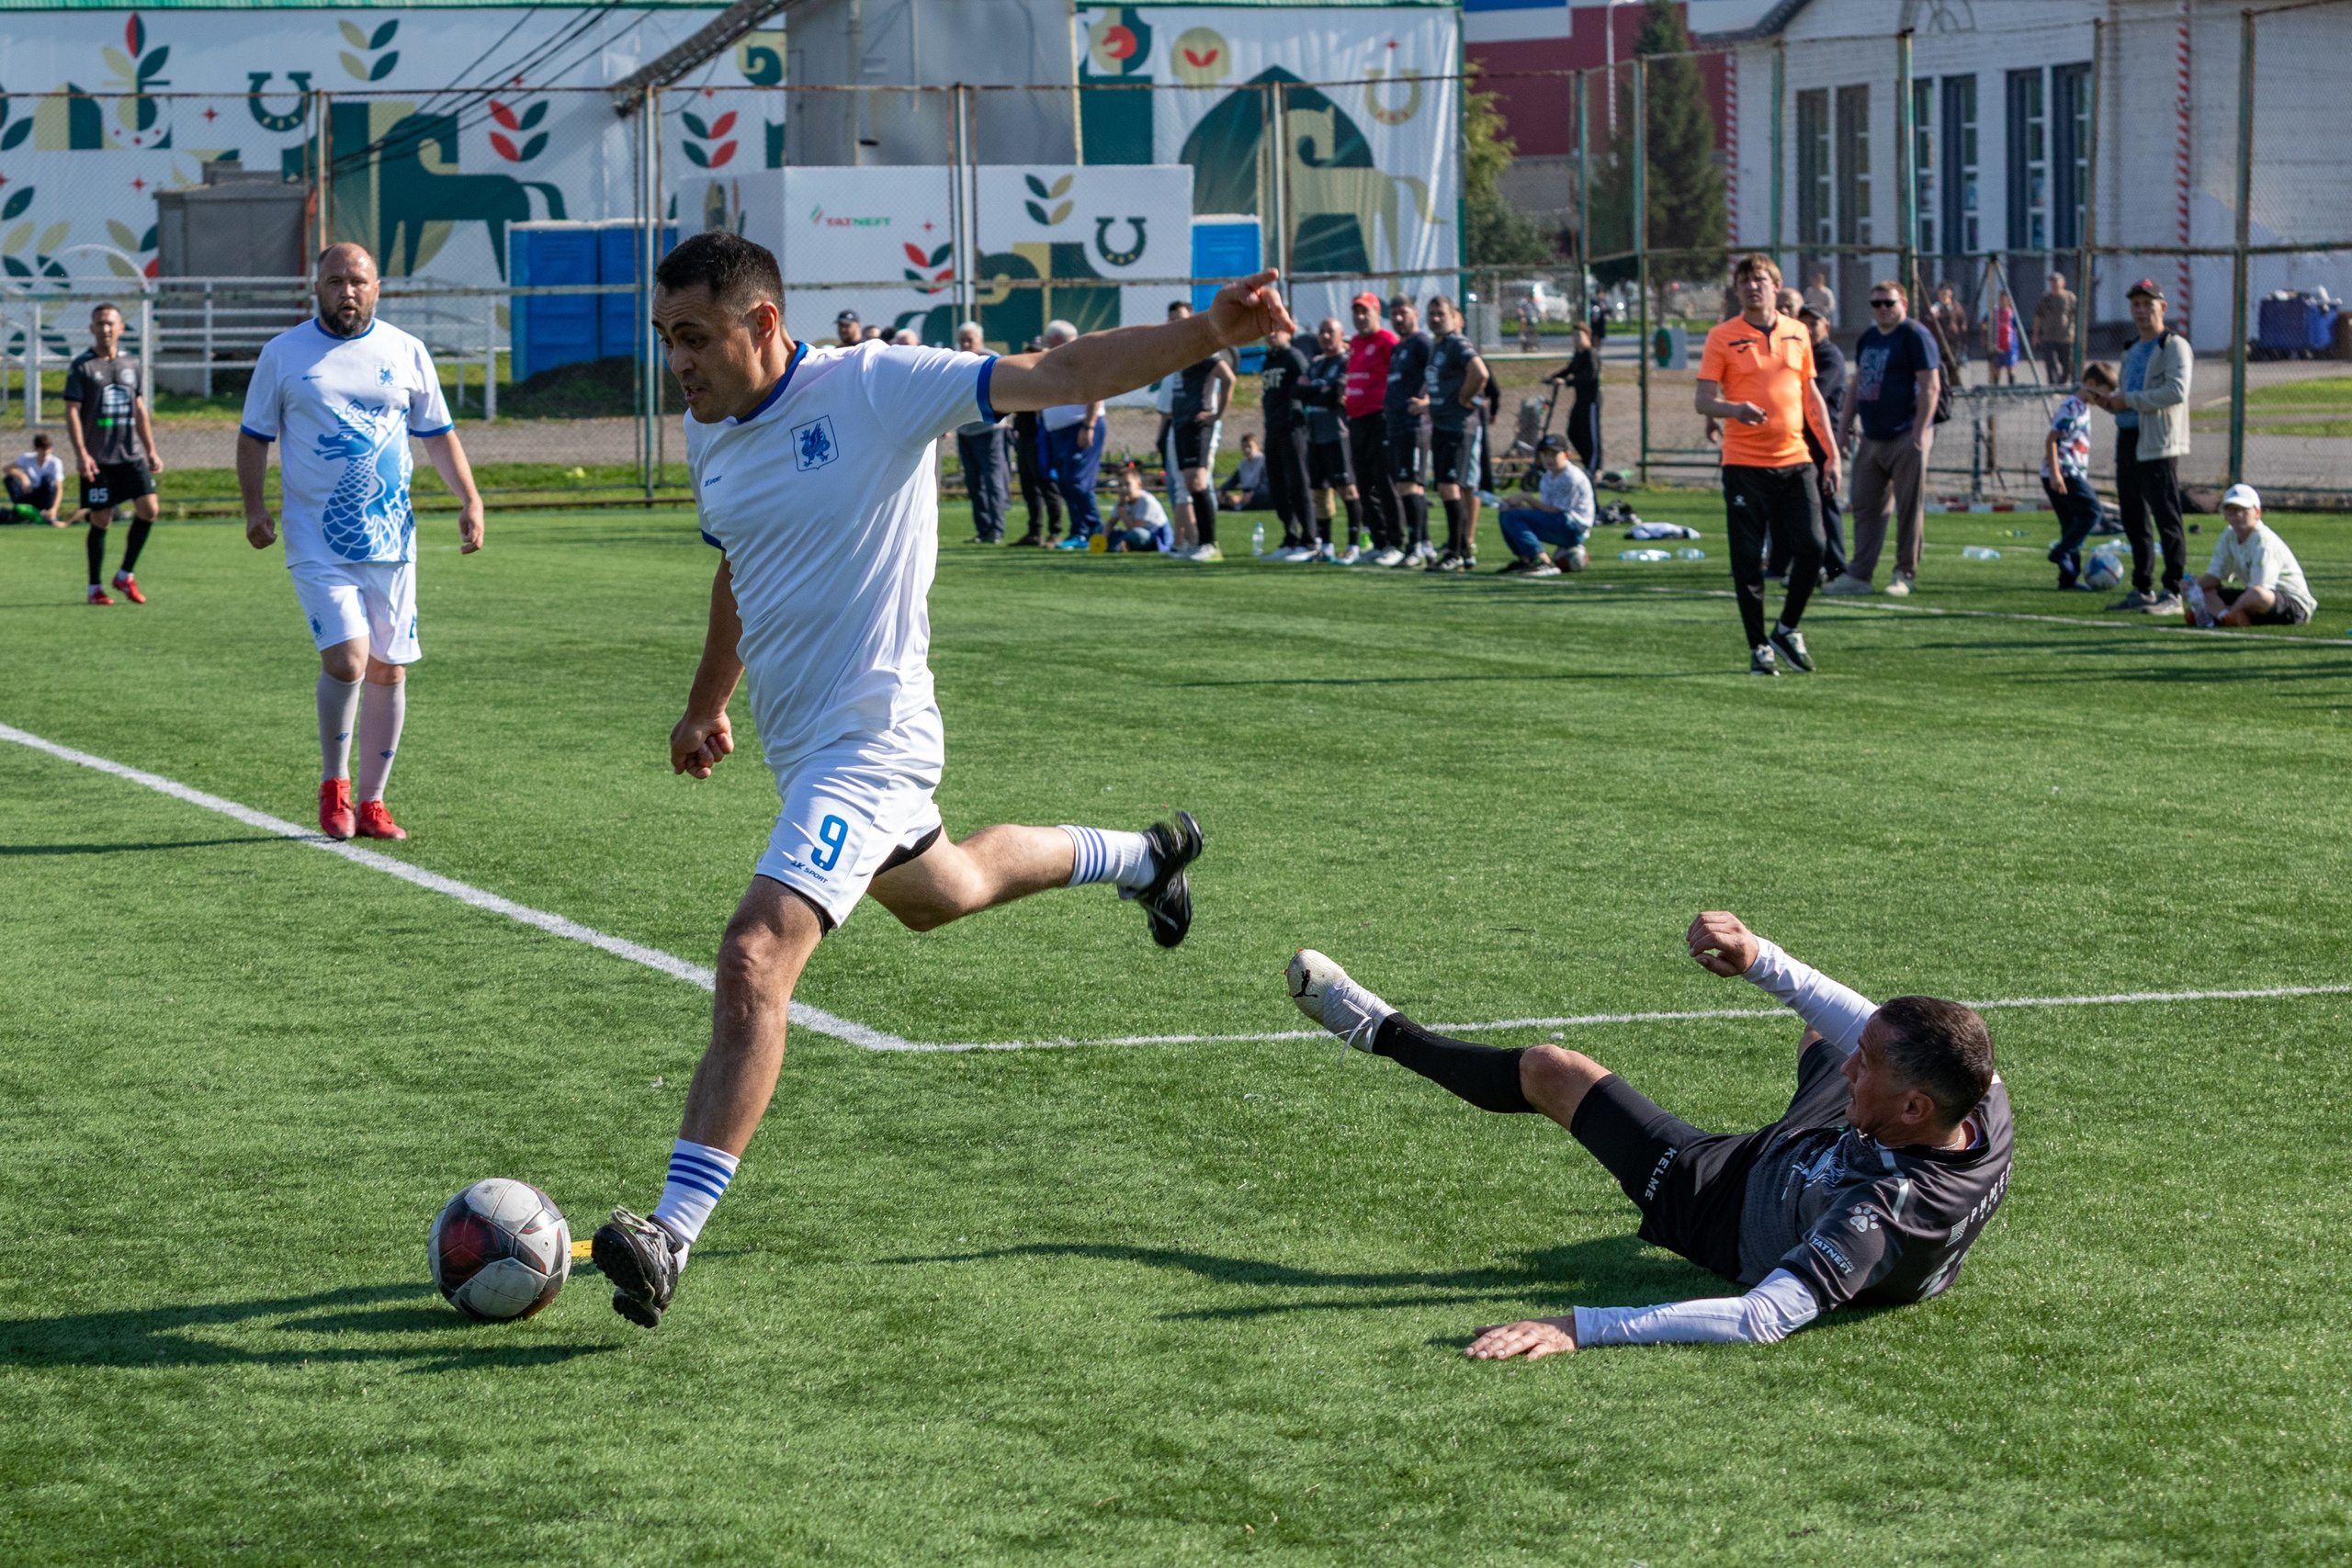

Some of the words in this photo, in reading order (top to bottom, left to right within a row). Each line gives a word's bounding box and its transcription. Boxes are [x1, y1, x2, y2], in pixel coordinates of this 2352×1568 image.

[88, 488, 108, 502] 85
[810, 814, 849, 872] 9
[803, 867, 829, 884] SPORT
[1645, 1147, 1678, 1201] KELME
[1811, 1237, 1853, 1275] TATNEFT
